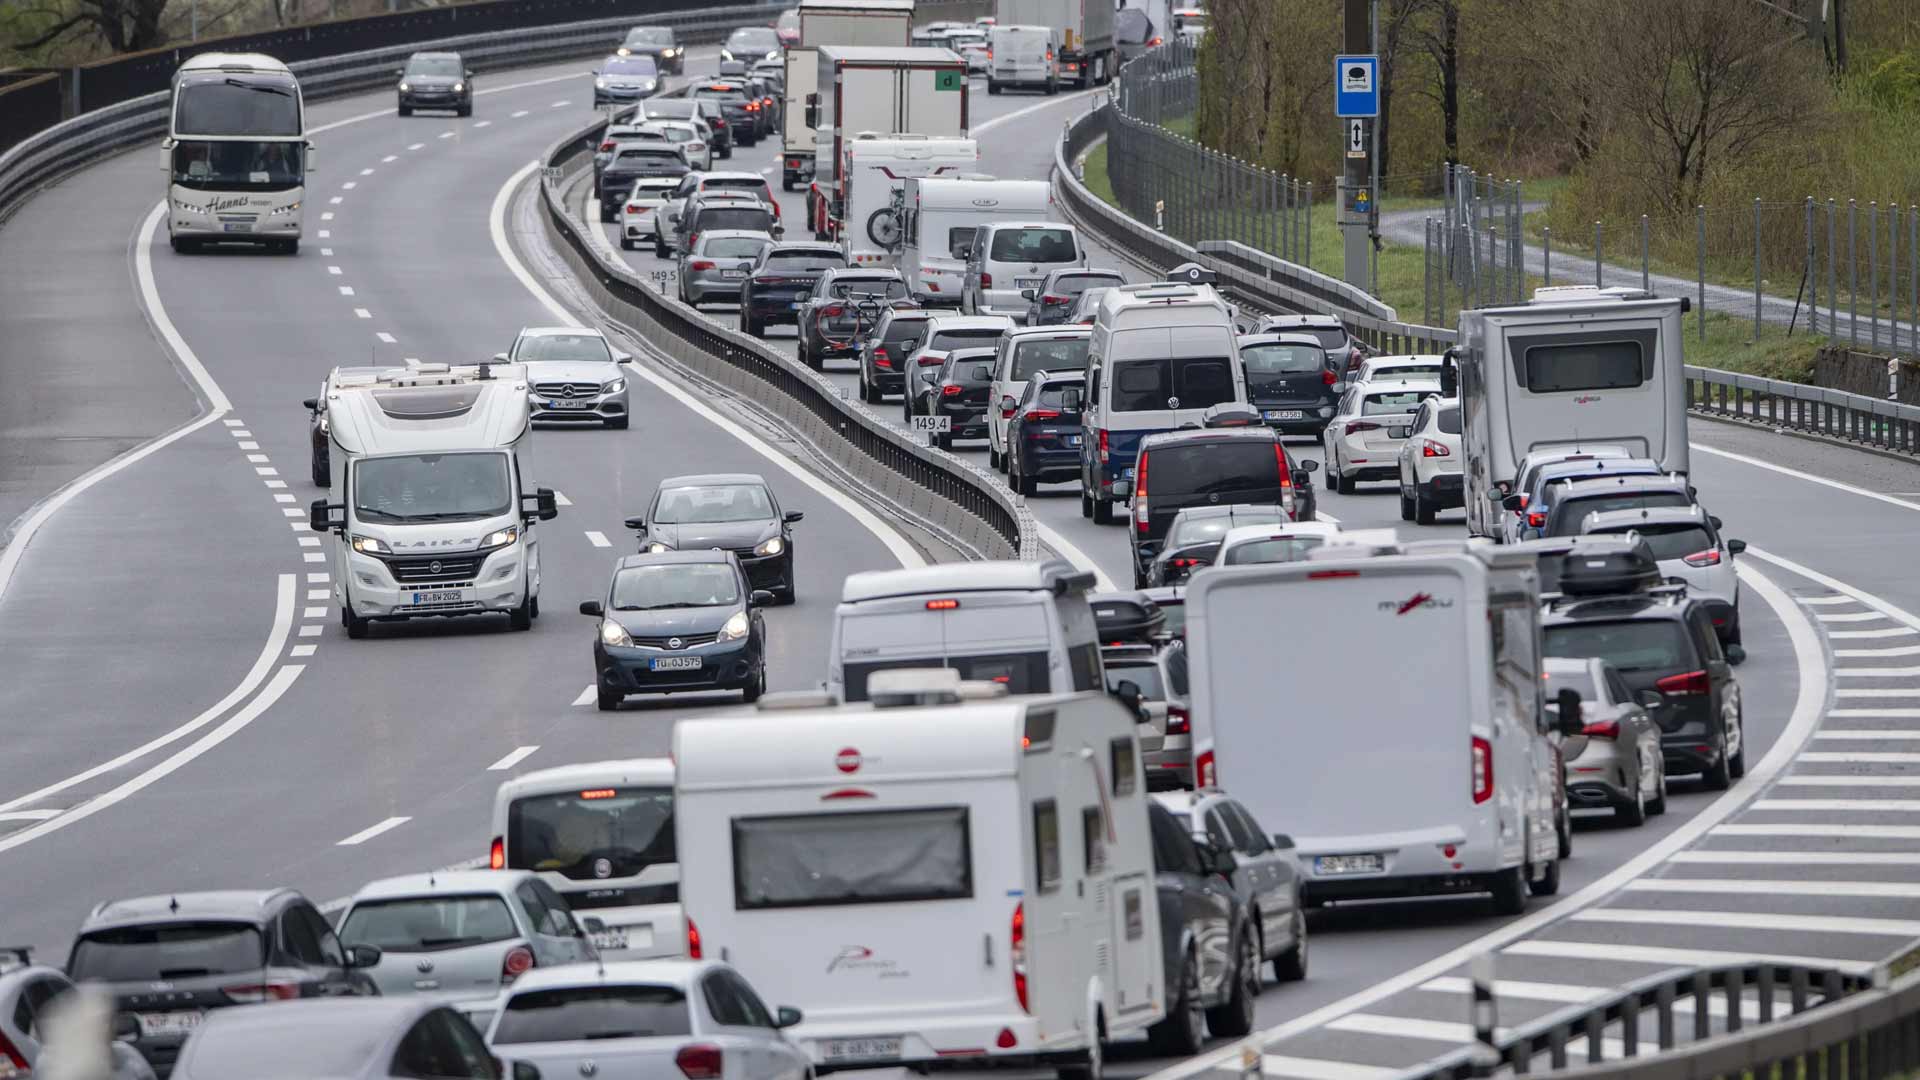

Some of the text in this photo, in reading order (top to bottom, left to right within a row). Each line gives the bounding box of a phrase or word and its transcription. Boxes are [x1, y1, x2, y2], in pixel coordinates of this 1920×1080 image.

[943, 74, 953, 87] d
[205, 196, 249, 213] Hannes
[651, 271, 676, 281] 149.5
[914, 417, 947, 430] 149.4
[393, 537, 478, 547] LAIKA
